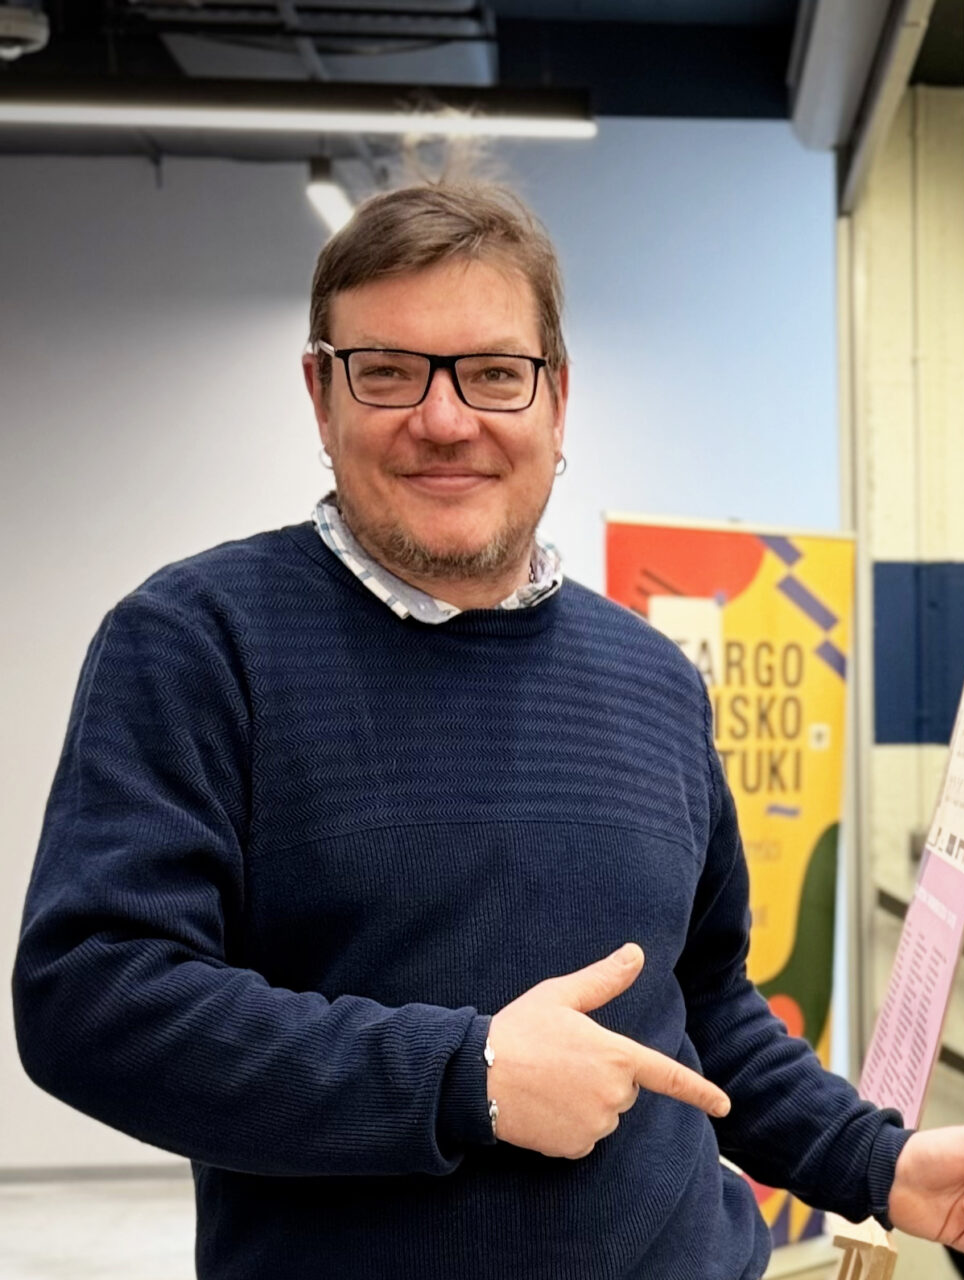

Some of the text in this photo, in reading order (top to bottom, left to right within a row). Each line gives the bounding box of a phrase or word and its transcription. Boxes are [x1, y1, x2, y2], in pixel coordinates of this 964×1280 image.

[675, 639, 804, 688] ARGO
[713, 693, 803, 741] ISKO
[718, 749, 803, 794] TUKI
